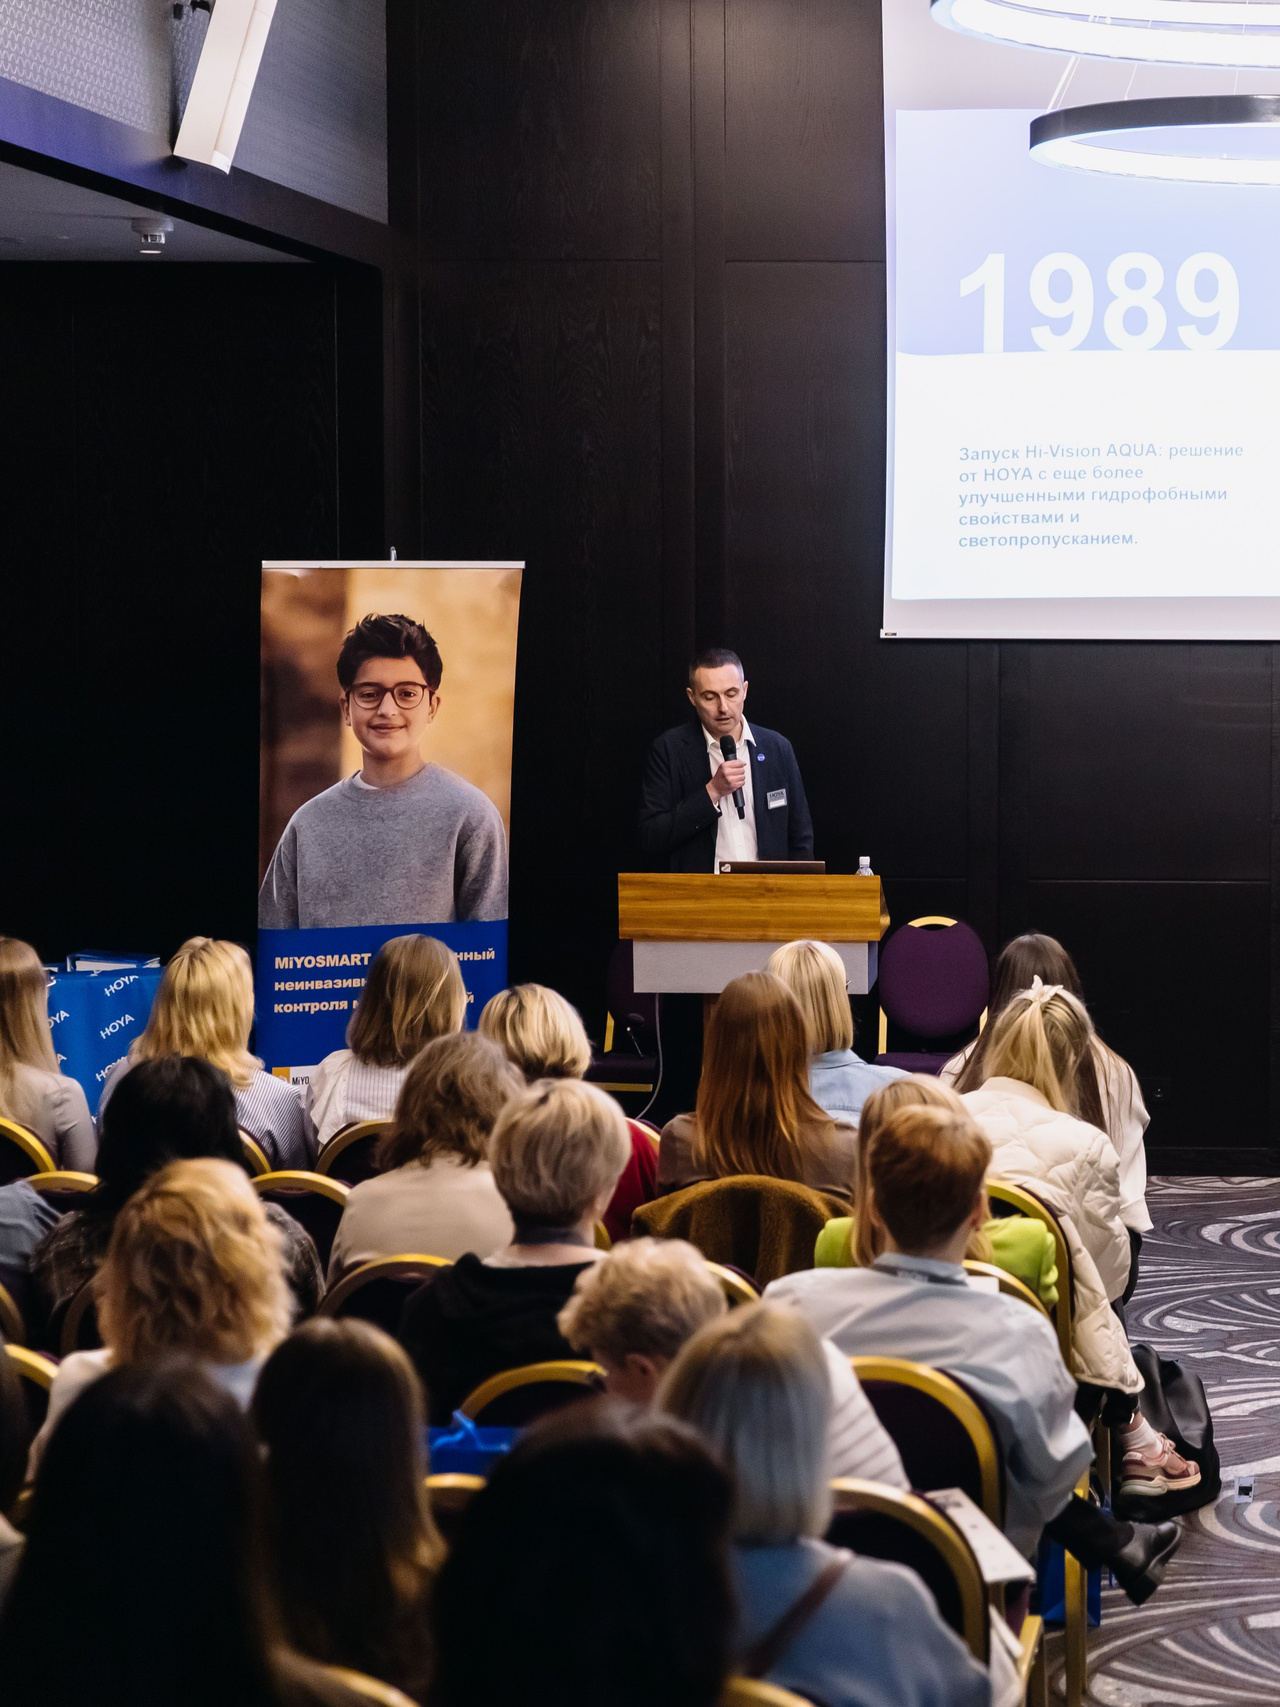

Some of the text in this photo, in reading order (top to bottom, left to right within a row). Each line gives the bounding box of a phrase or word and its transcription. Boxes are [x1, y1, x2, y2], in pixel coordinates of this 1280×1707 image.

[959, 251, 1240, 353] 1989
[958, 442, 1244, 464] Запуск Hi-Vision AQUA: решение
[958, 471, 979, 483] от
[983, 466, 1033, 482] HOYA
[1052, 469, 1087, 482] еще
[1092, 465, 1144, 480] более
[958, 486, 1228, 508] улучшенными гидрофобными
[958, 511, 1080, 527] свойствами и
[958, 533, 1138, 550] светопропусканием.
[274, 953, 372, 970] MiYOSMART
[273, 1000, 348, 1015] контроля
[48, 1010, 70, 1029] OYA
[99, 1013, 135, 1040] HOYA
